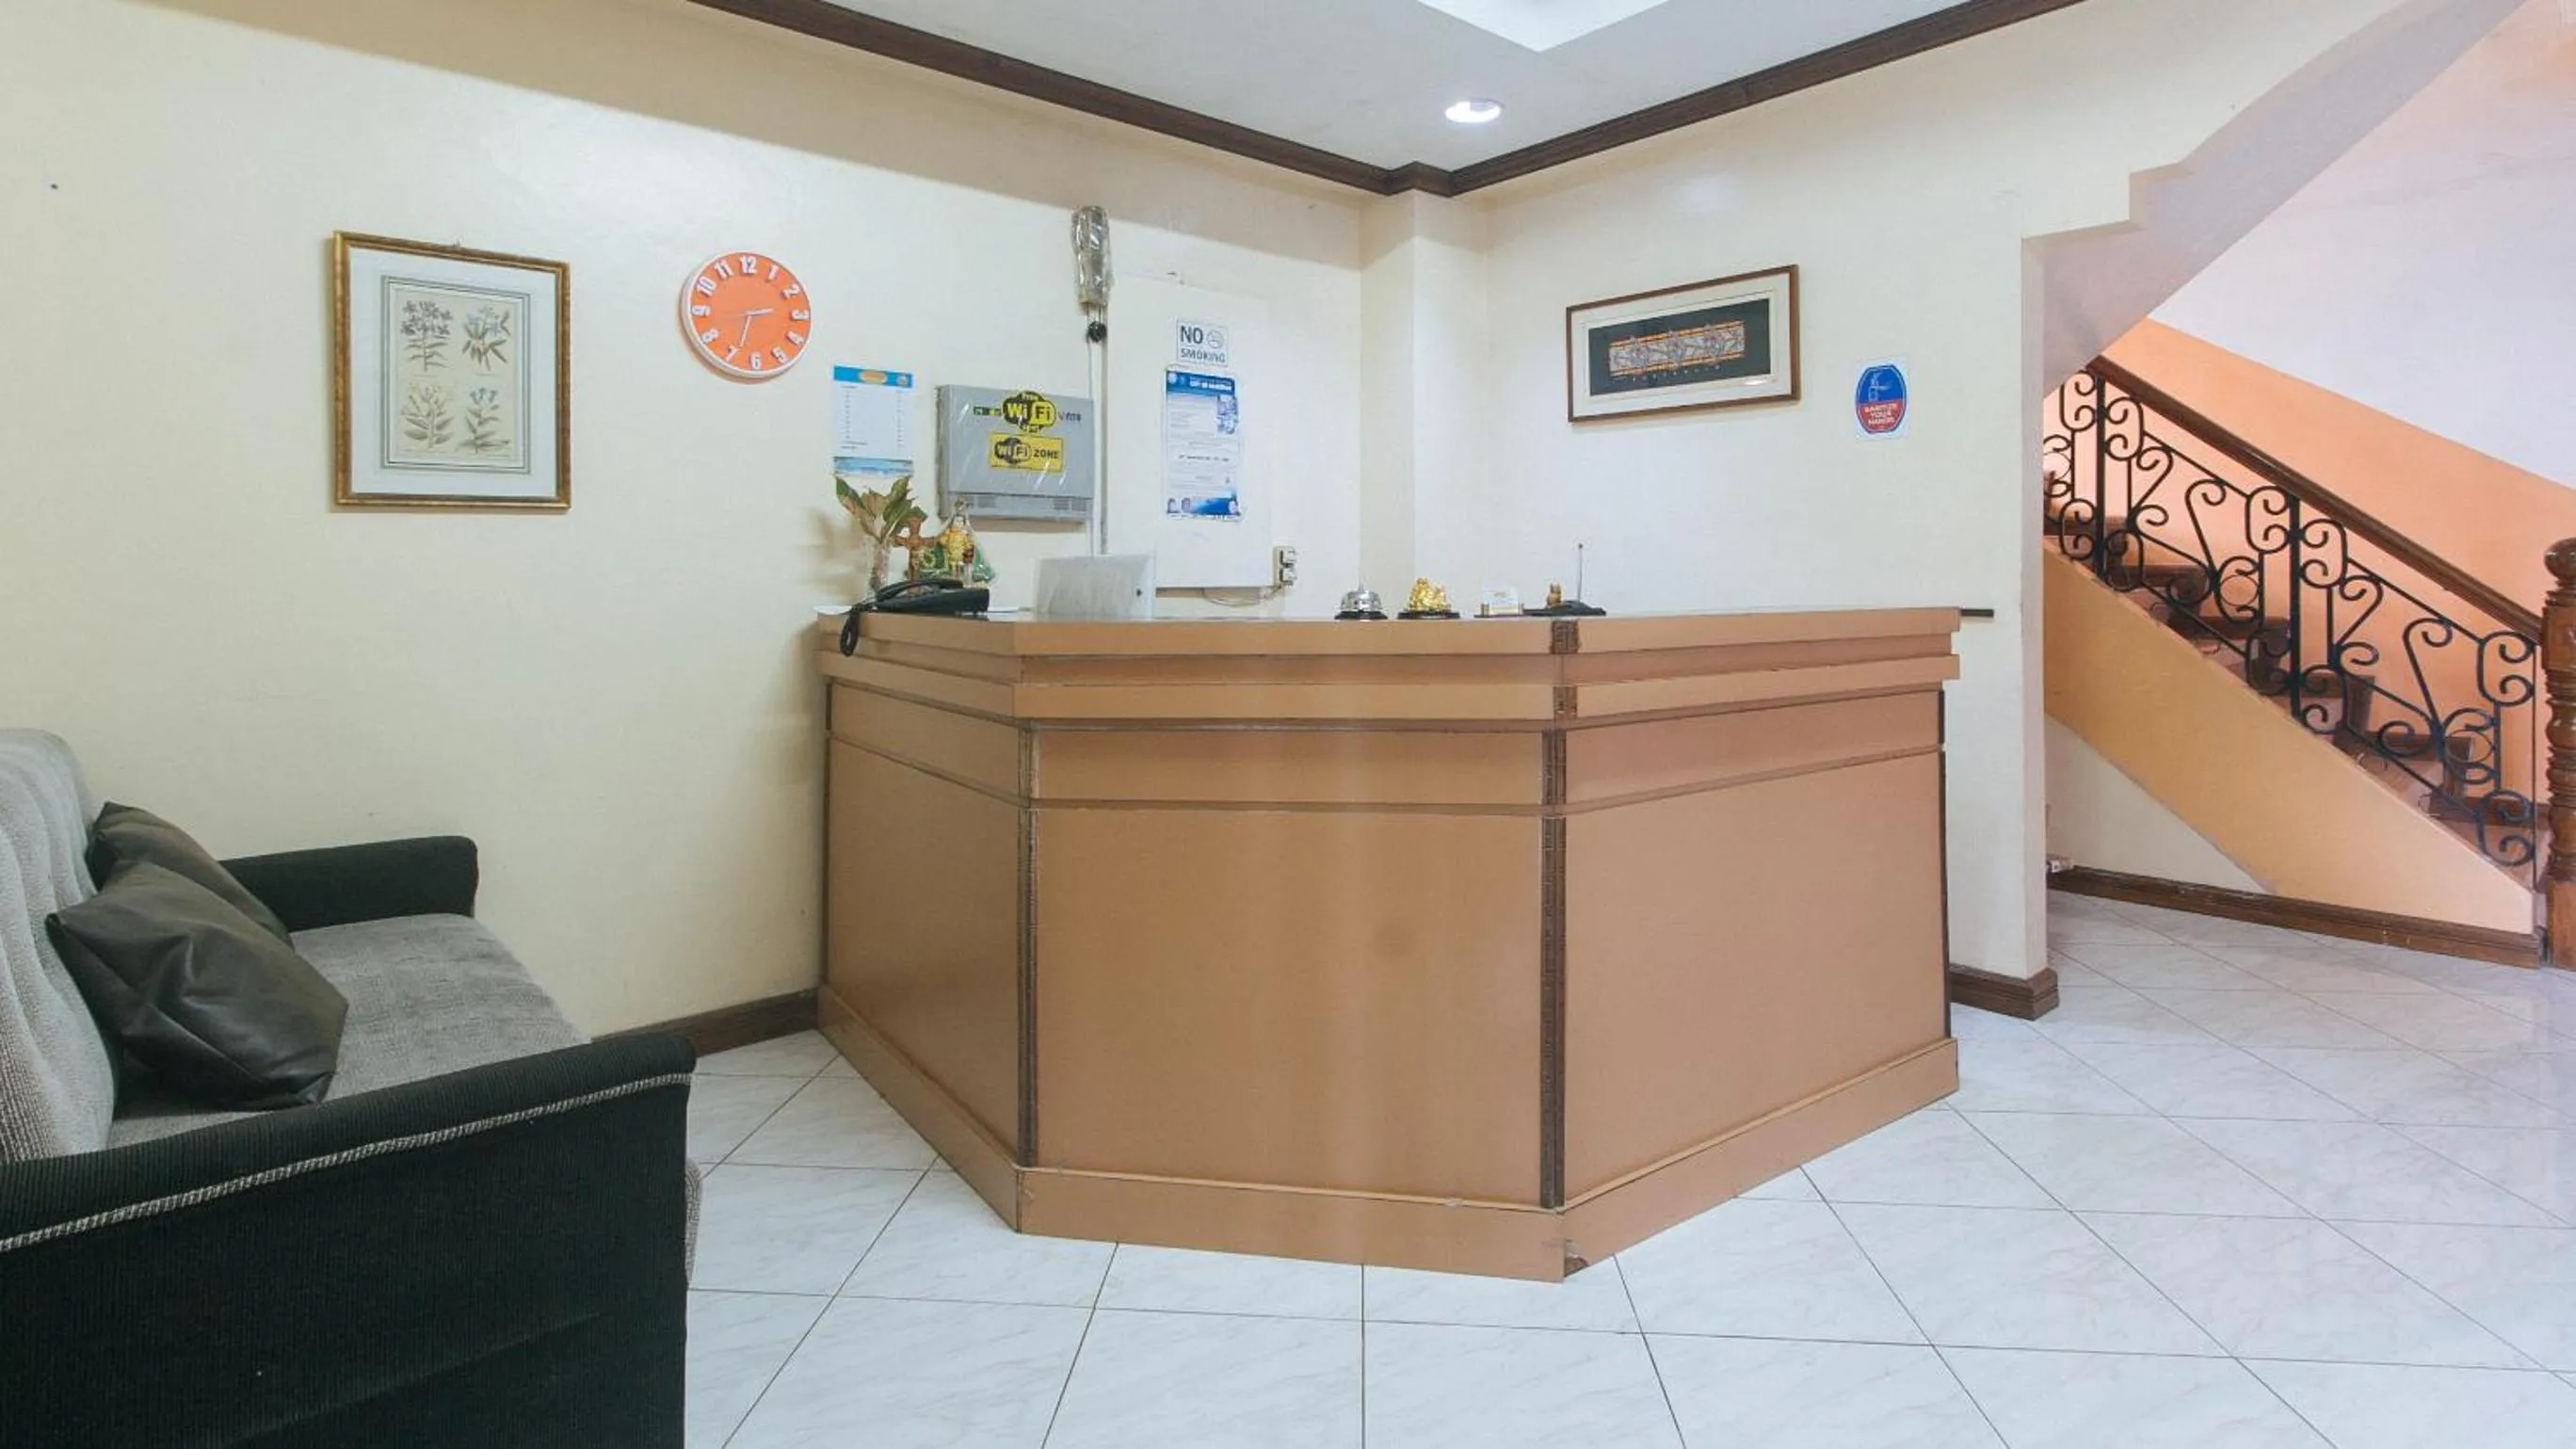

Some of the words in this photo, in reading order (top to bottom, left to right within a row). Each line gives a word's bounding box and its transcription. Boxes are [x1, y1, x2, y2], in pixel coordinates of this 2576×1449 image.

[714, 259, 733, 280] 11
[739, 255, 757, 275] 12
[767, 265, 780, 281] 1
[696, 276, 716, 297] 10
[782, 283, 800, 298] 2
[691, 304, 711, 316] 9
[790, 310, 811, 321] 3
[701, 330, 719, 344] 8
[786, 330, 805, 347] 4
[1180, 325, 1203, 345] NO
[726, 345, 738, 362] 7
[749, 351, 762, 370] 6
[772, 346, 788, 363] 5
[1180, 347, 1226, 363] SMOKING
[1033, 450, 1060, 459] ZONE
